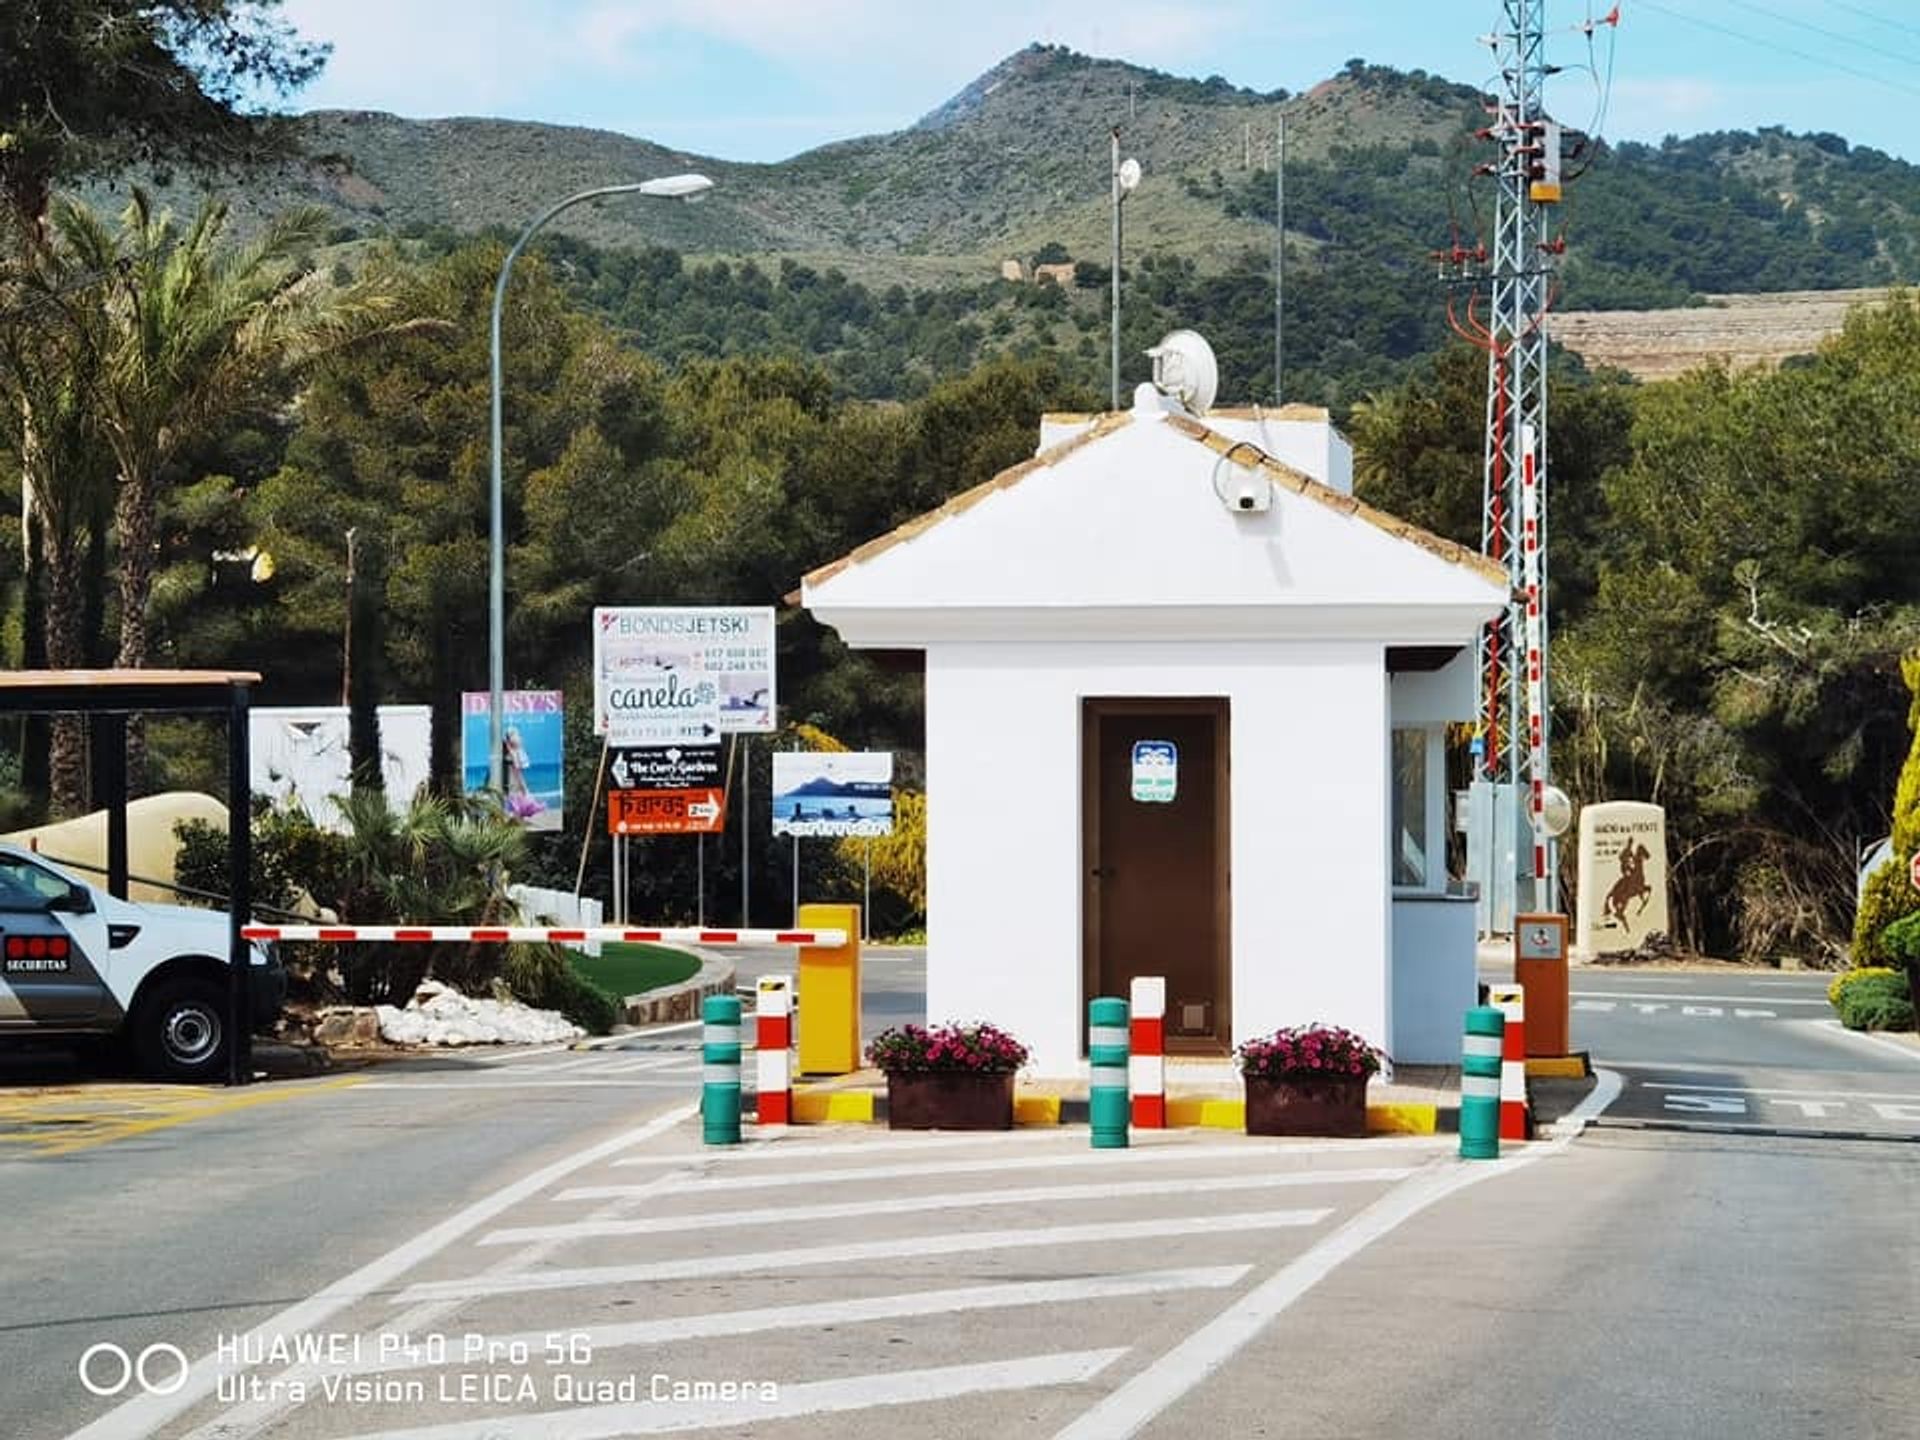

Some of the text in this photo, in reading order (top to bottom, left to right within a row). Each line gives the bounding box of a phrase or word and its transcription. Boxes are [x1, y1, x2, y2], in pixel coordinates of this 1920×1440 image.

[610, 674, 697, 709] canela
[6, 959, 68, 971] SECURITAS
[1573, 1001, 1777, 1018] STOP
